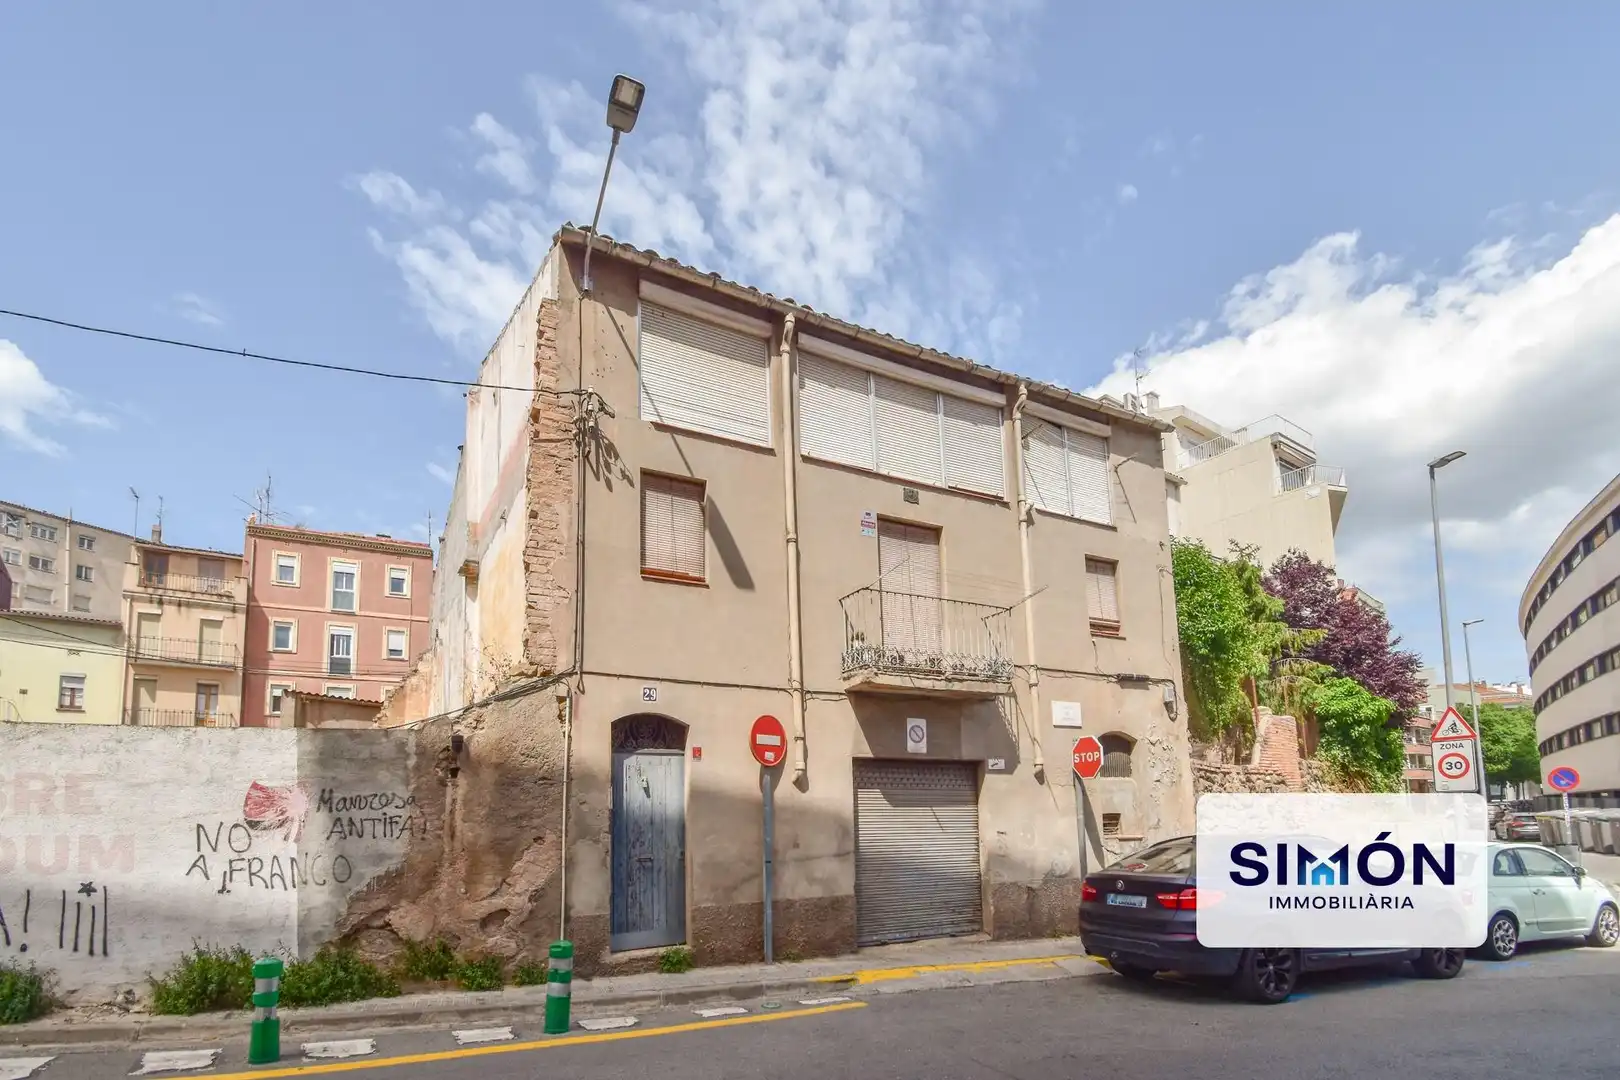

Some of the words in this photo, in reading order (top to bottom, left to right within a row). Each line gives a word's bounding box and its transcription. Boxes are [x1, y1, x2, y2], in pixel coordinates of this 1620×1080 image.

[643, 688, 657, 701] 29
[1440, 742, 1465, 750] ZONA
[1074, 751, 1100, 764] STOP
[1445, 761, 1463, 770] 30
[196, 821, 252, 853] NO
[185, 854, 211, 881] A
[229, 852, 352, 891] FRANCO
